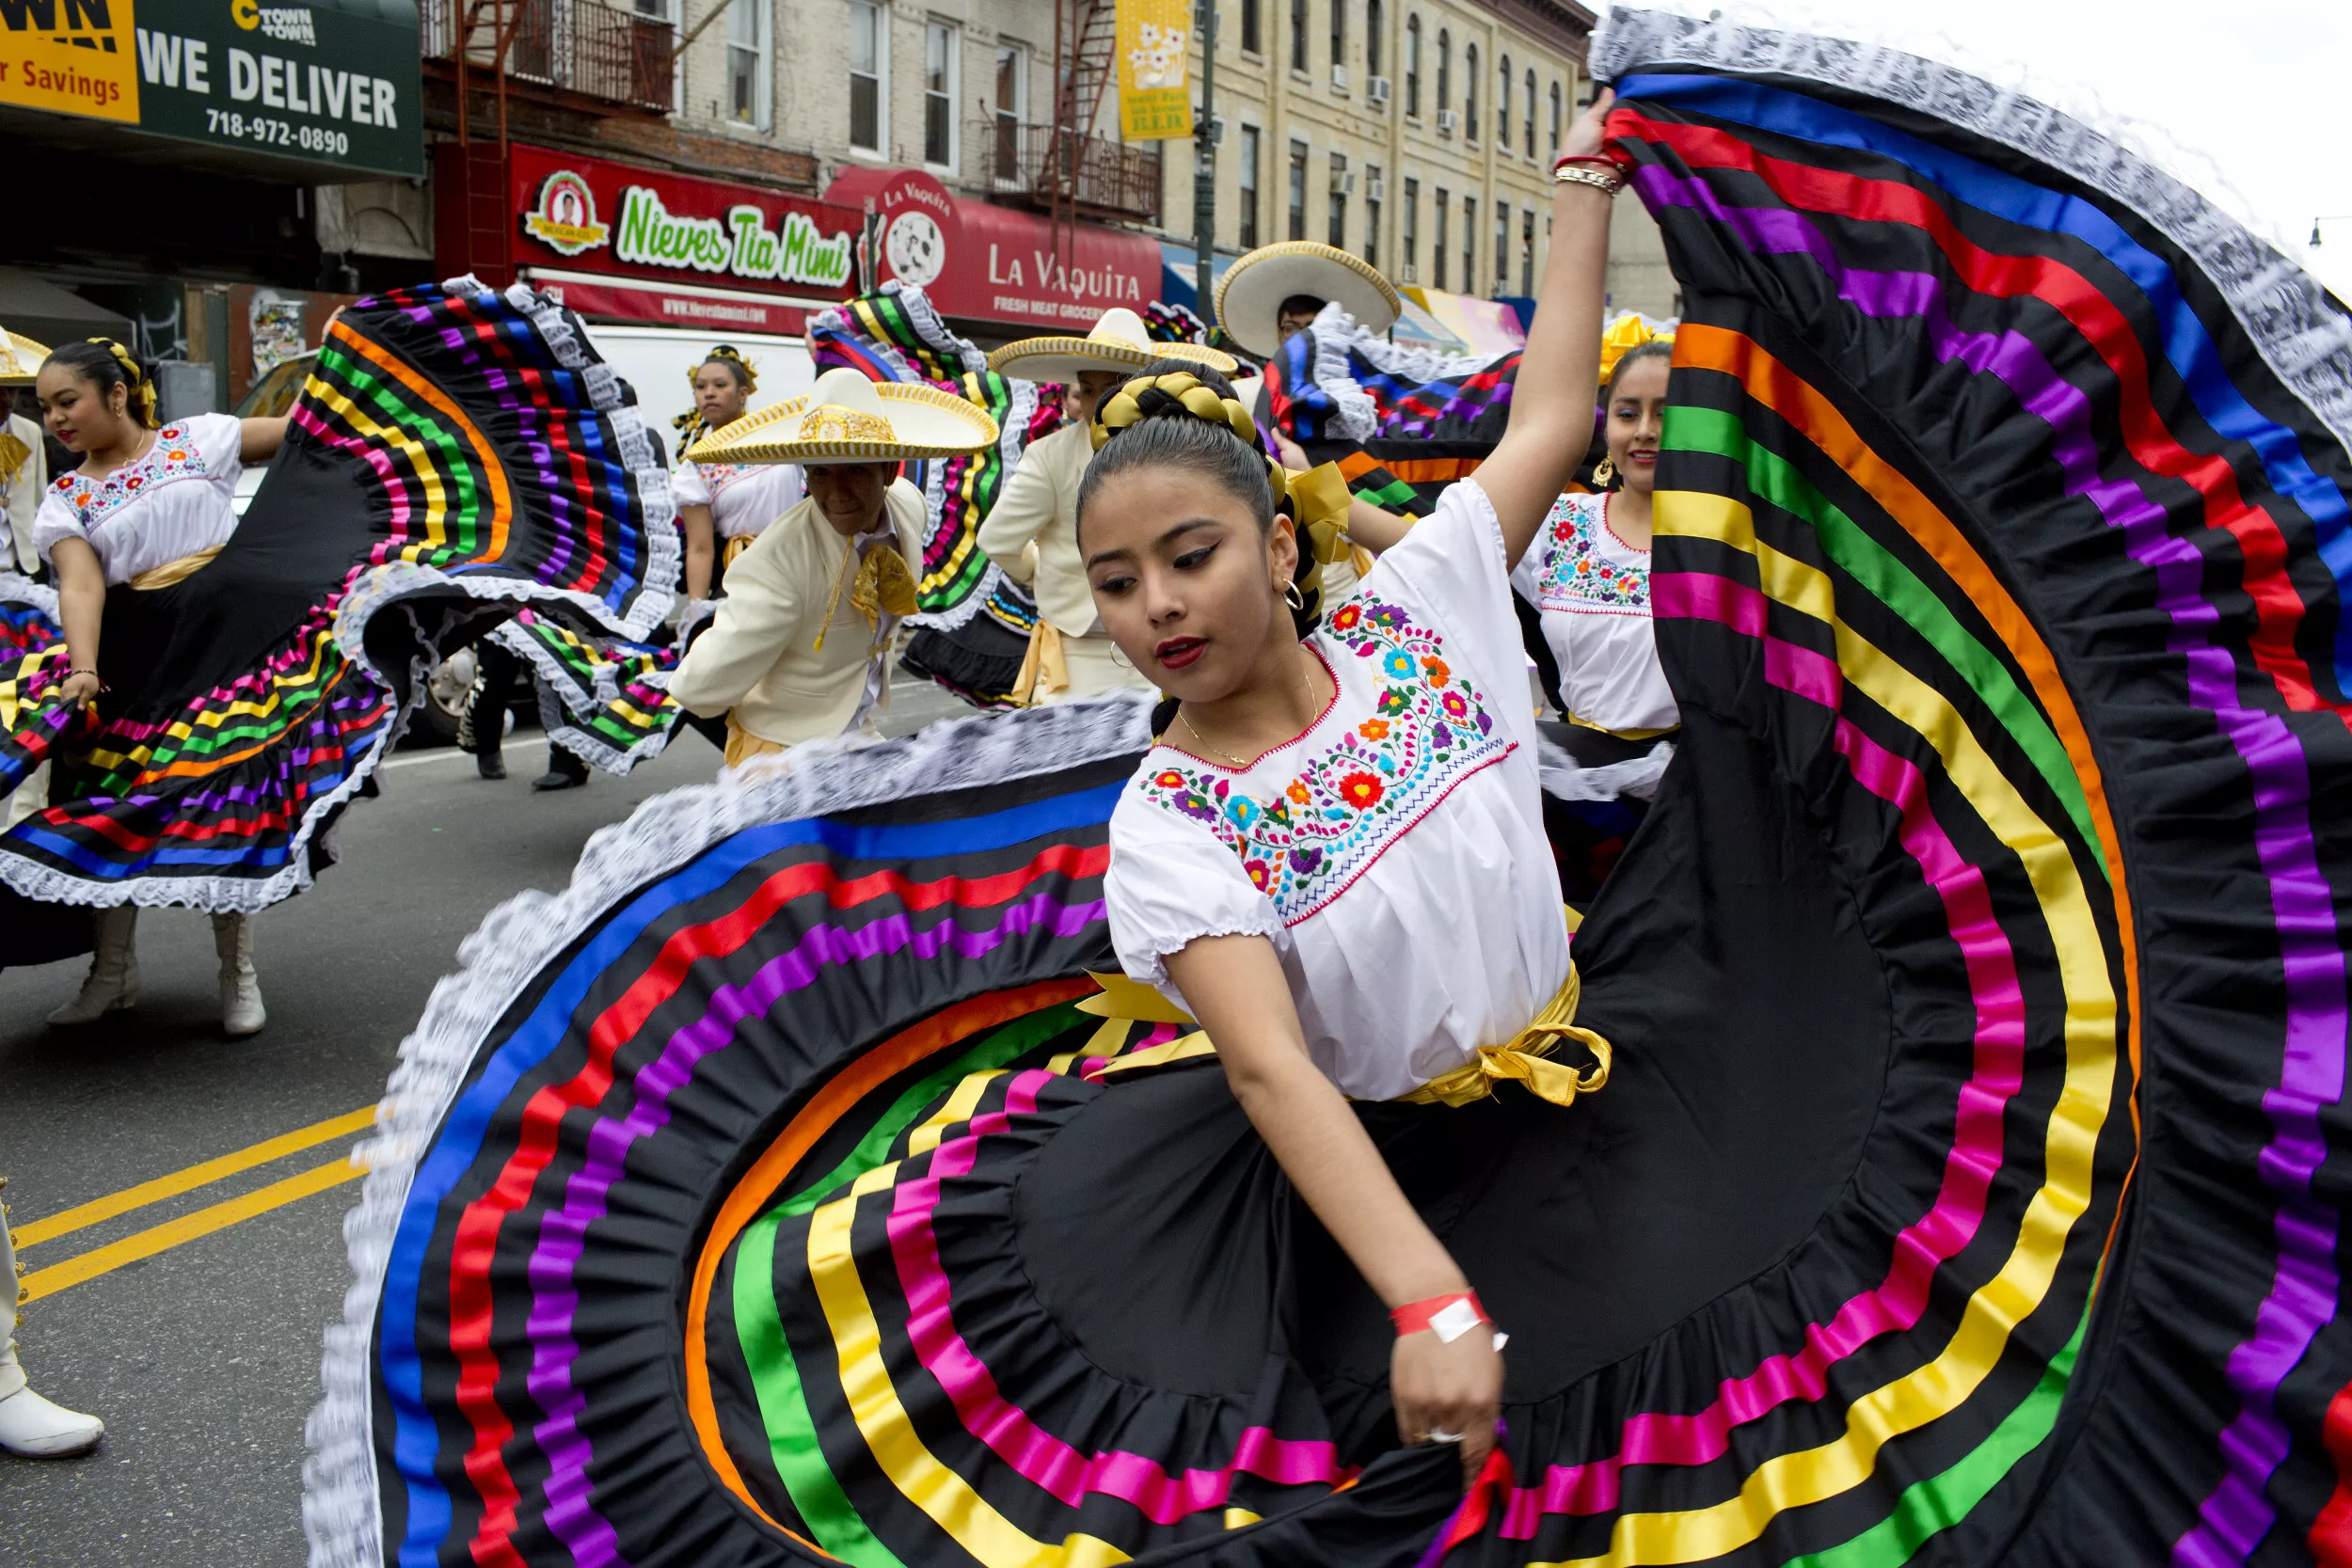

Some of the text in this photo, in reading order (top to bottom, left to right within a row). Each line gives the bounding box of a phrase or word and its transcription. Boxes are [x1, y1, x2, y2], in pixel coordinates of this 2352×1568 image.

[259, 8, 313, 26] TOWN
[23, 59, 120, 106] Savings
[136, 27, 397, 129] WE DELIVER
[206, 108, 348, 155] 718-972-0890
[623, 195, 846, 281] Nieves Tia Mimi
[993, 295, 1029, 312] FRESH
[1030, 299, 1058, 316] MEAT
